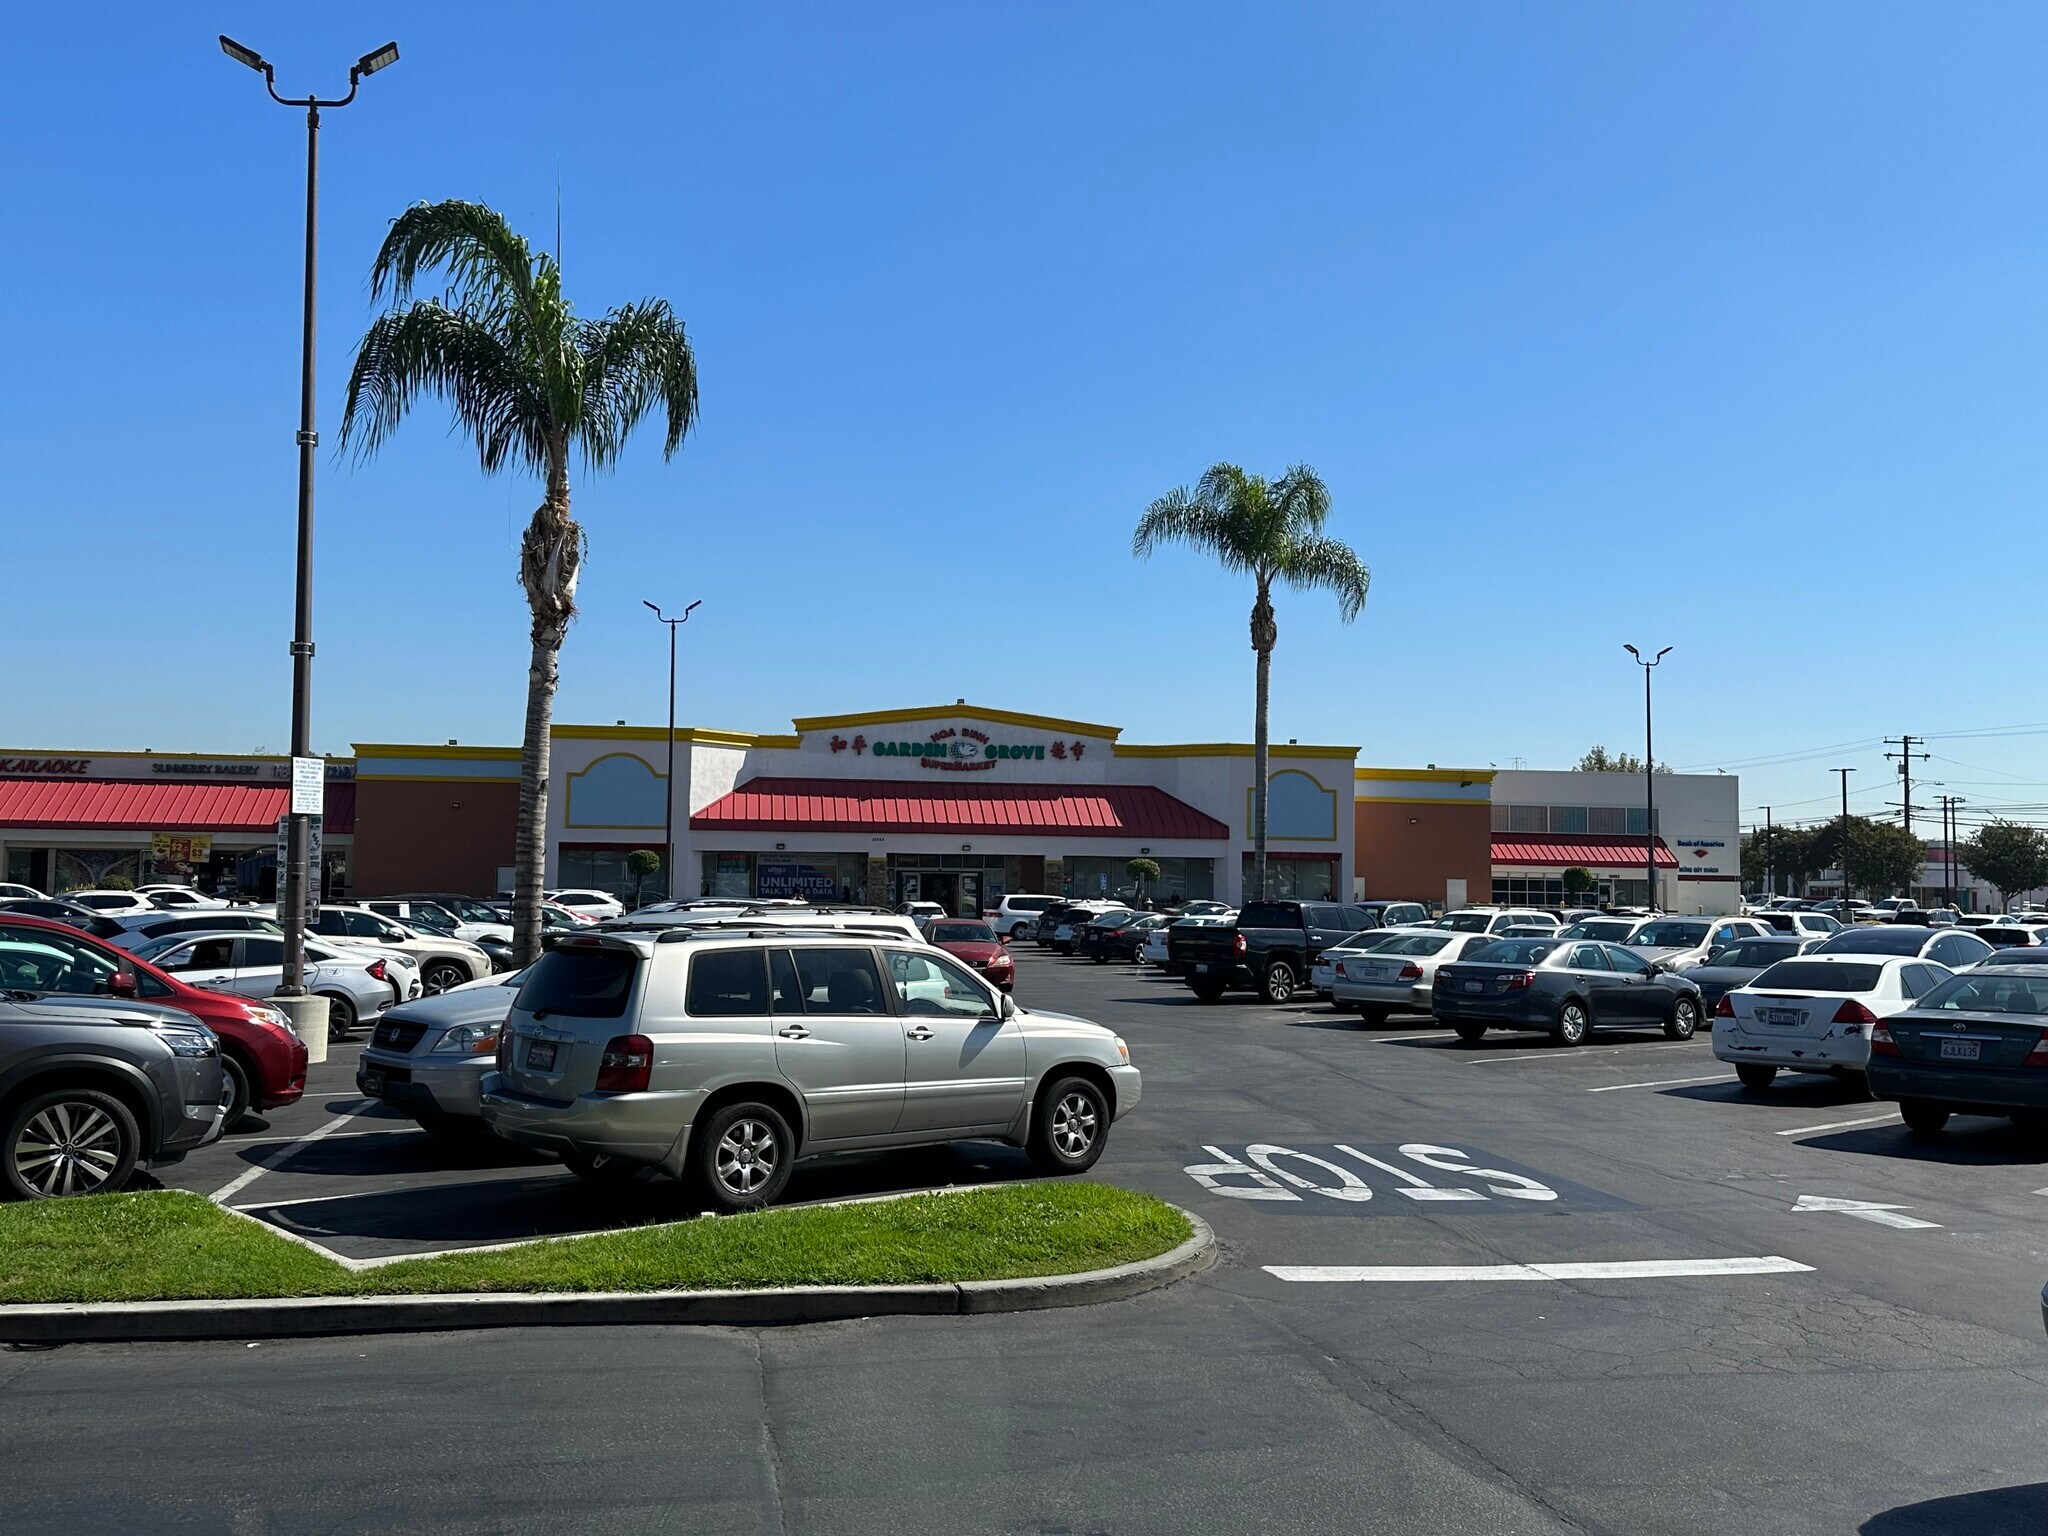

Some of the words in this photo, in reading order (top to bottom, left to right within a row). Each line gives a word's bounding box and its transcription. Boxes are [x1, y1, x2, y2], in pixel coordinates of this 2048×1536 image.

[930, 728, 956, 744] HOA
[961, 728, 990, 745] BINH
[872, 741, 947, 758] GARDEN
[984, 744, 1045, 760] GROVE
[0, 758, 91, 774] KARAOKE
[152, 763, 213, 774] SUNMERRY
[214, 764, 260, 775] BAKERY
[920, 757, 998, 772] SUPERMARKET
[191, 848, 203, 857] $3
[760, 877, 833, 888] UNLIMITED
[1942, 1046, 1978, 1057] 6JLK135
[1183, 1144, 1559, 1203] STOP
